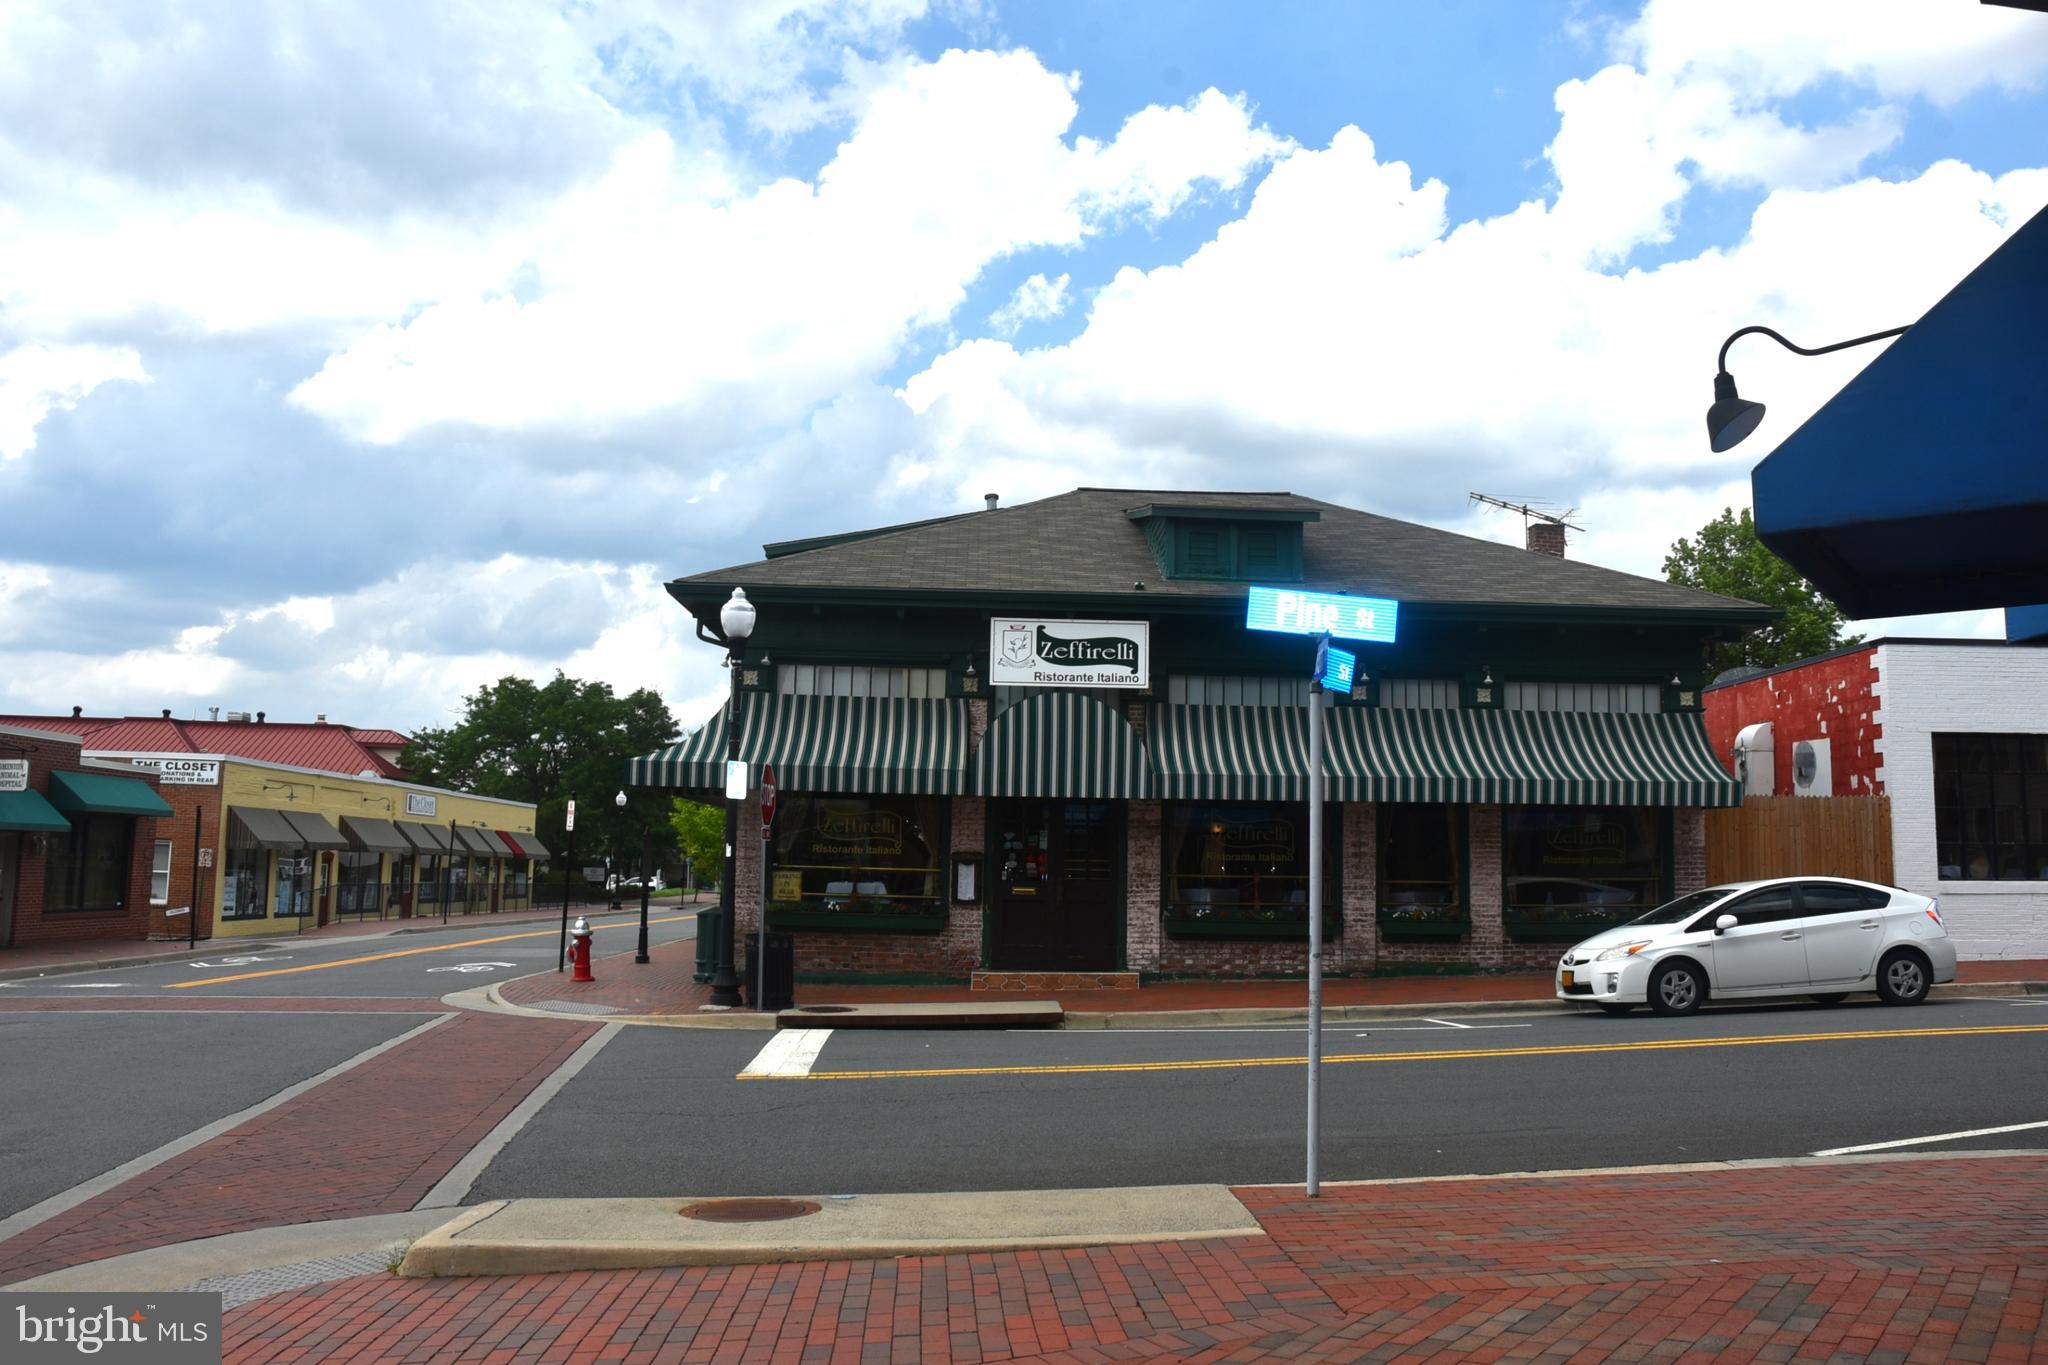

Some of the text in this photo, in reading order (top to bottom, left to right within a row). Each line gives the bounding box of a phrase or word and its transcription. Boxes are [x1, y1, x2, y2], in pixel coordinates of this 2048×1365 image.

[1276, 593, 1339, 629] Pine
[1040, 640, 1135, 660] Zeffirelli
[1034, 671, 1140, 684] Ristorante Italiano
[165, 761, 217, 772] CLOSET
[761, 783, 775, 806] STOP
[812, 843, 902, 856] Ristorante Italiano
